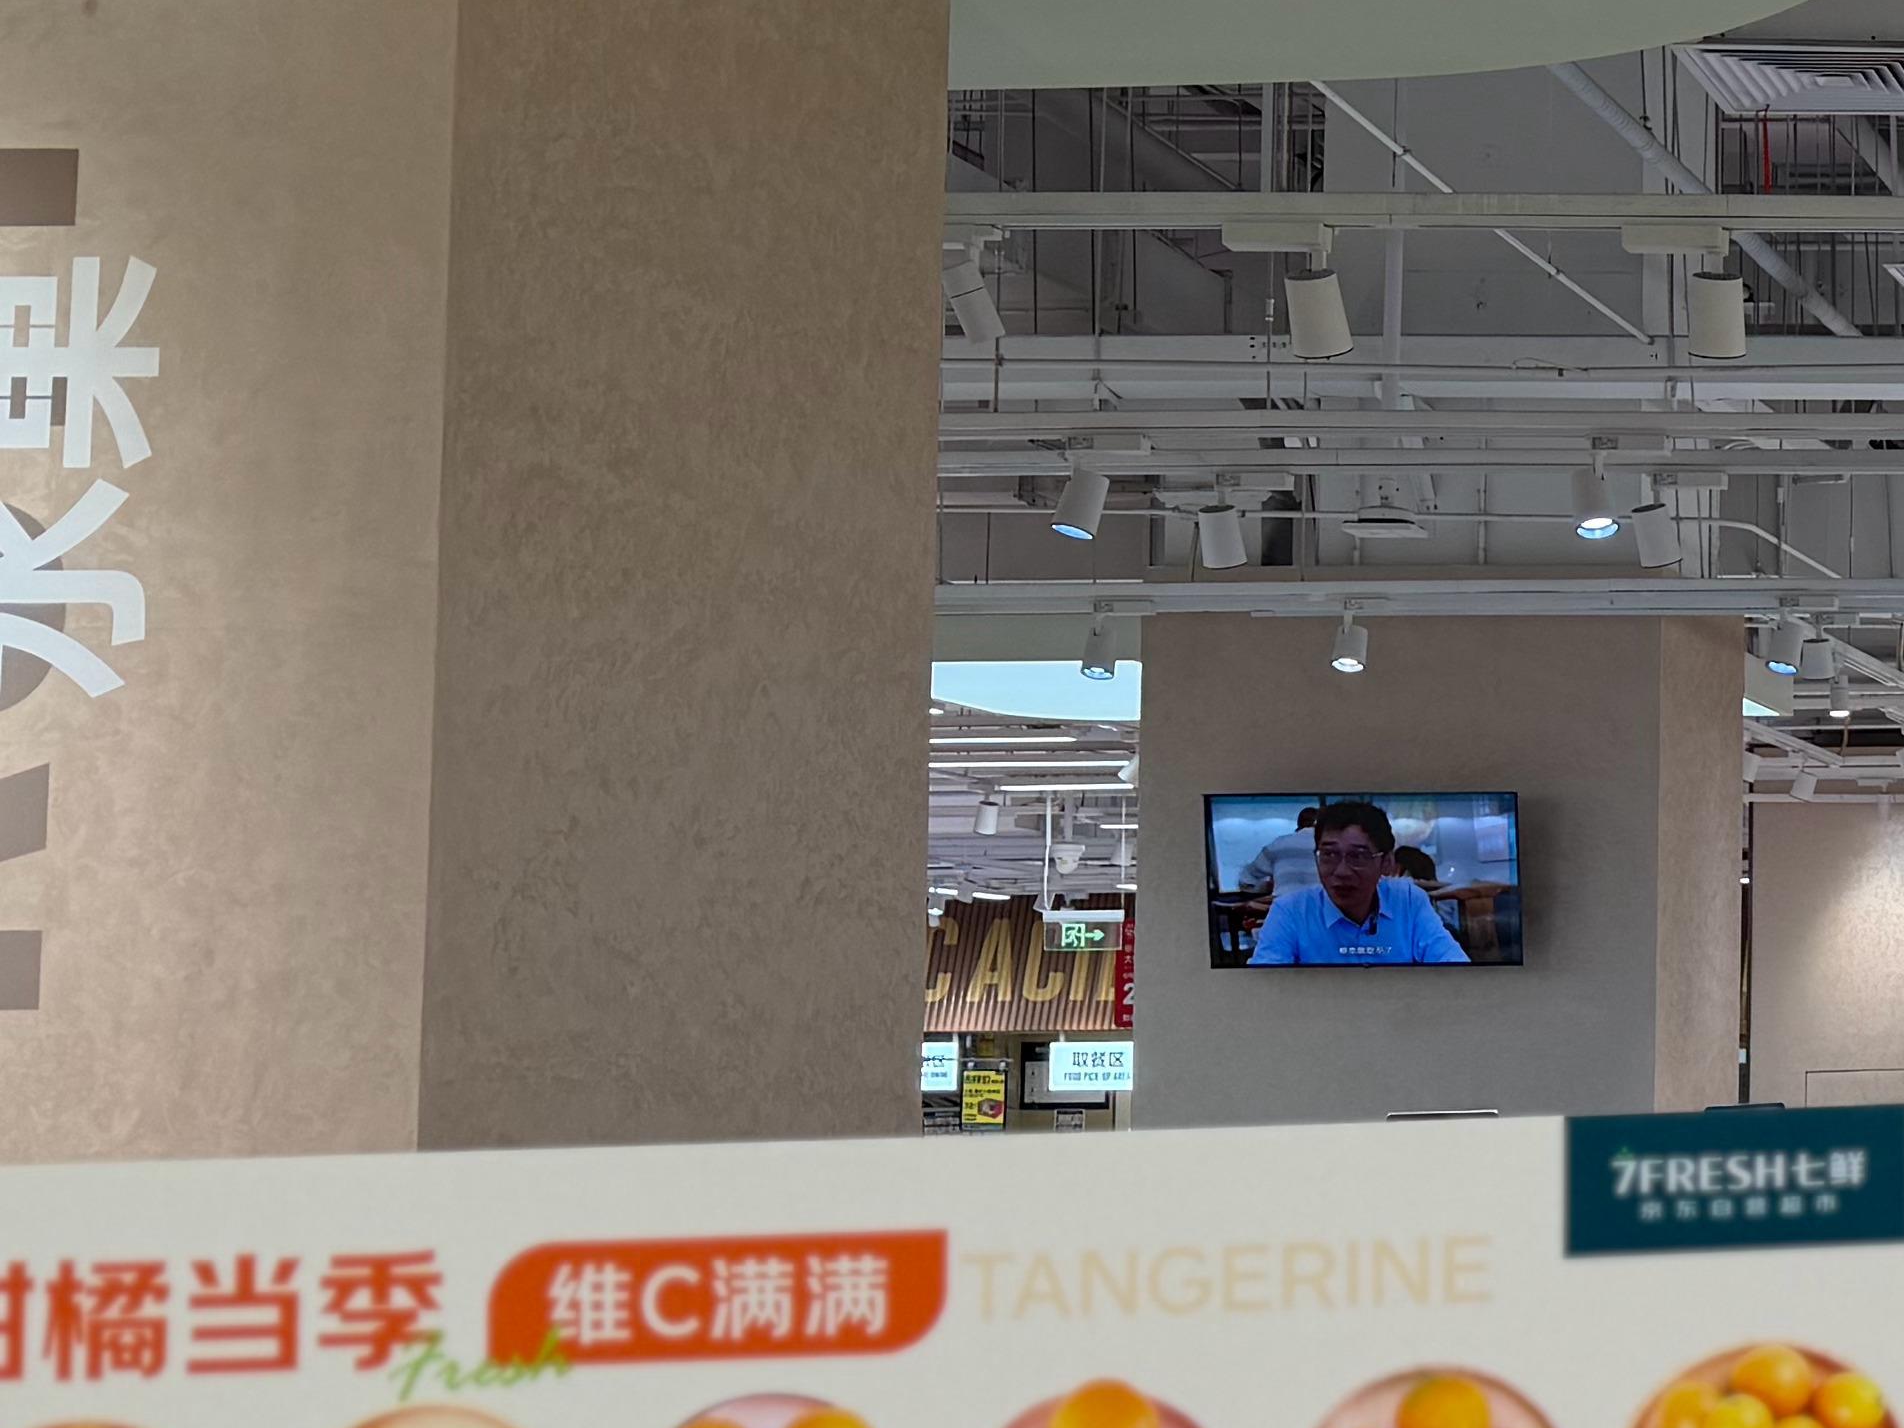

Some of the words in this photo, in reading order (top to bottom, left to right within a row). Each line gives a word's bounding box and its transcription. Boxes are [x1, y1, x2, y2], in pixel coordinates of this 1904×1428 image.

[1611, 1149, 1867, 1199] 7FRESH七鲜
[547, 1253, 889, 1347] 维C满满
[963, 1235, 1495, 1322] TANGERINE
[389, 1328, 573, 1402] Fresh
